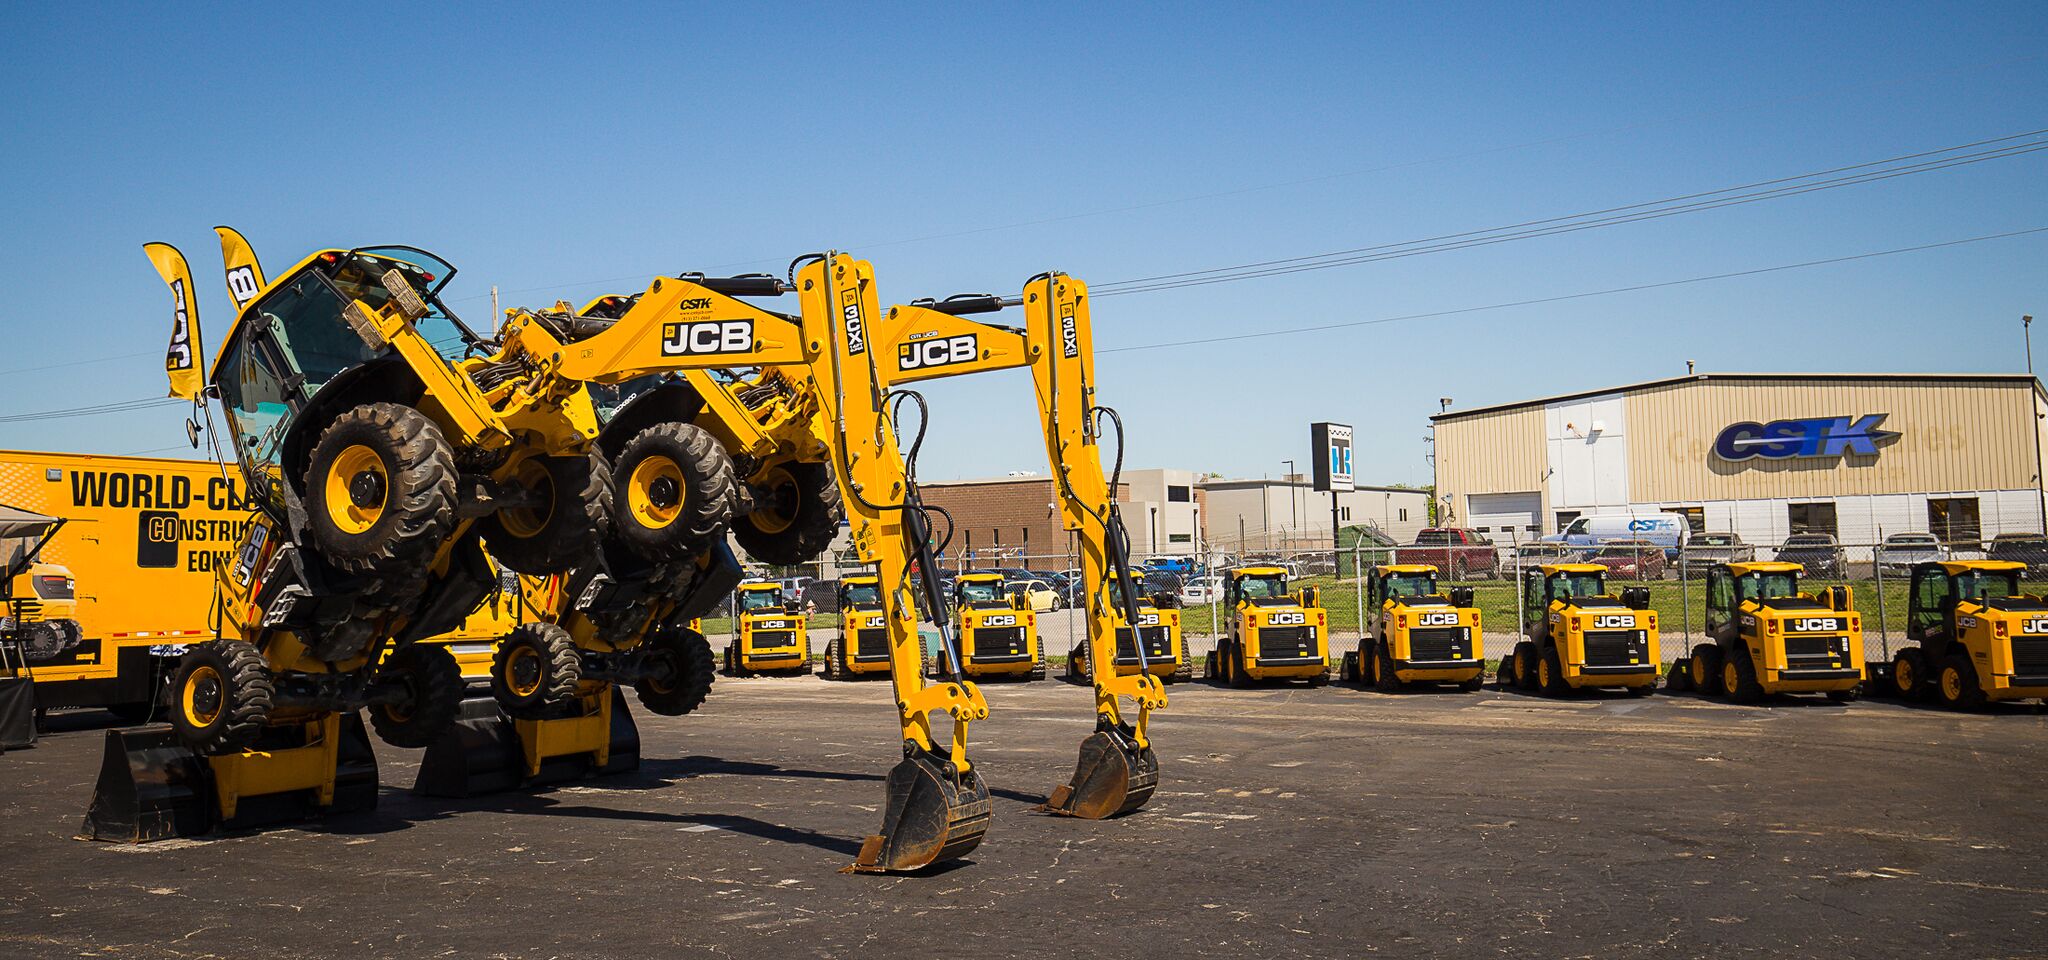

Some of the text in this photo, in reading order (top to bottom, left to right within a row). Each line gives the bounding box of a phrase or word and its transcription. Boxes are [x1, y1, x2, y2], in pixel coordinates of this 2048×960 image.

[680, 297, 712, 311] CSTK
[845, 305, 862, 346] 3CX
[664, 321, 752, 354] JCB
[1063, 317, 1077, 350] 3CX
[900, 336, 977, 369] JCB
[1715, 413, 1891, 461] CSTK
[1628, 520, 1673, 532] CSTK
[240, 525, 267, 586] JCB
[761, 620, 785, 629] JCB
[867, 617, 885, 627] JC
[983, 615, 1015, 626] JCB
[1269, 613, 1304, 625] JCB
[1420, 613, 1458, 625] JCB
[1595, 615, 1635, 628] JCB
[1741, 616, 1755, 626] JCB
[1795, 618, 1838, 631] JCB
[1958, 617, 1977, 628] JCB
[2023, 619, 2048, 633] JC
